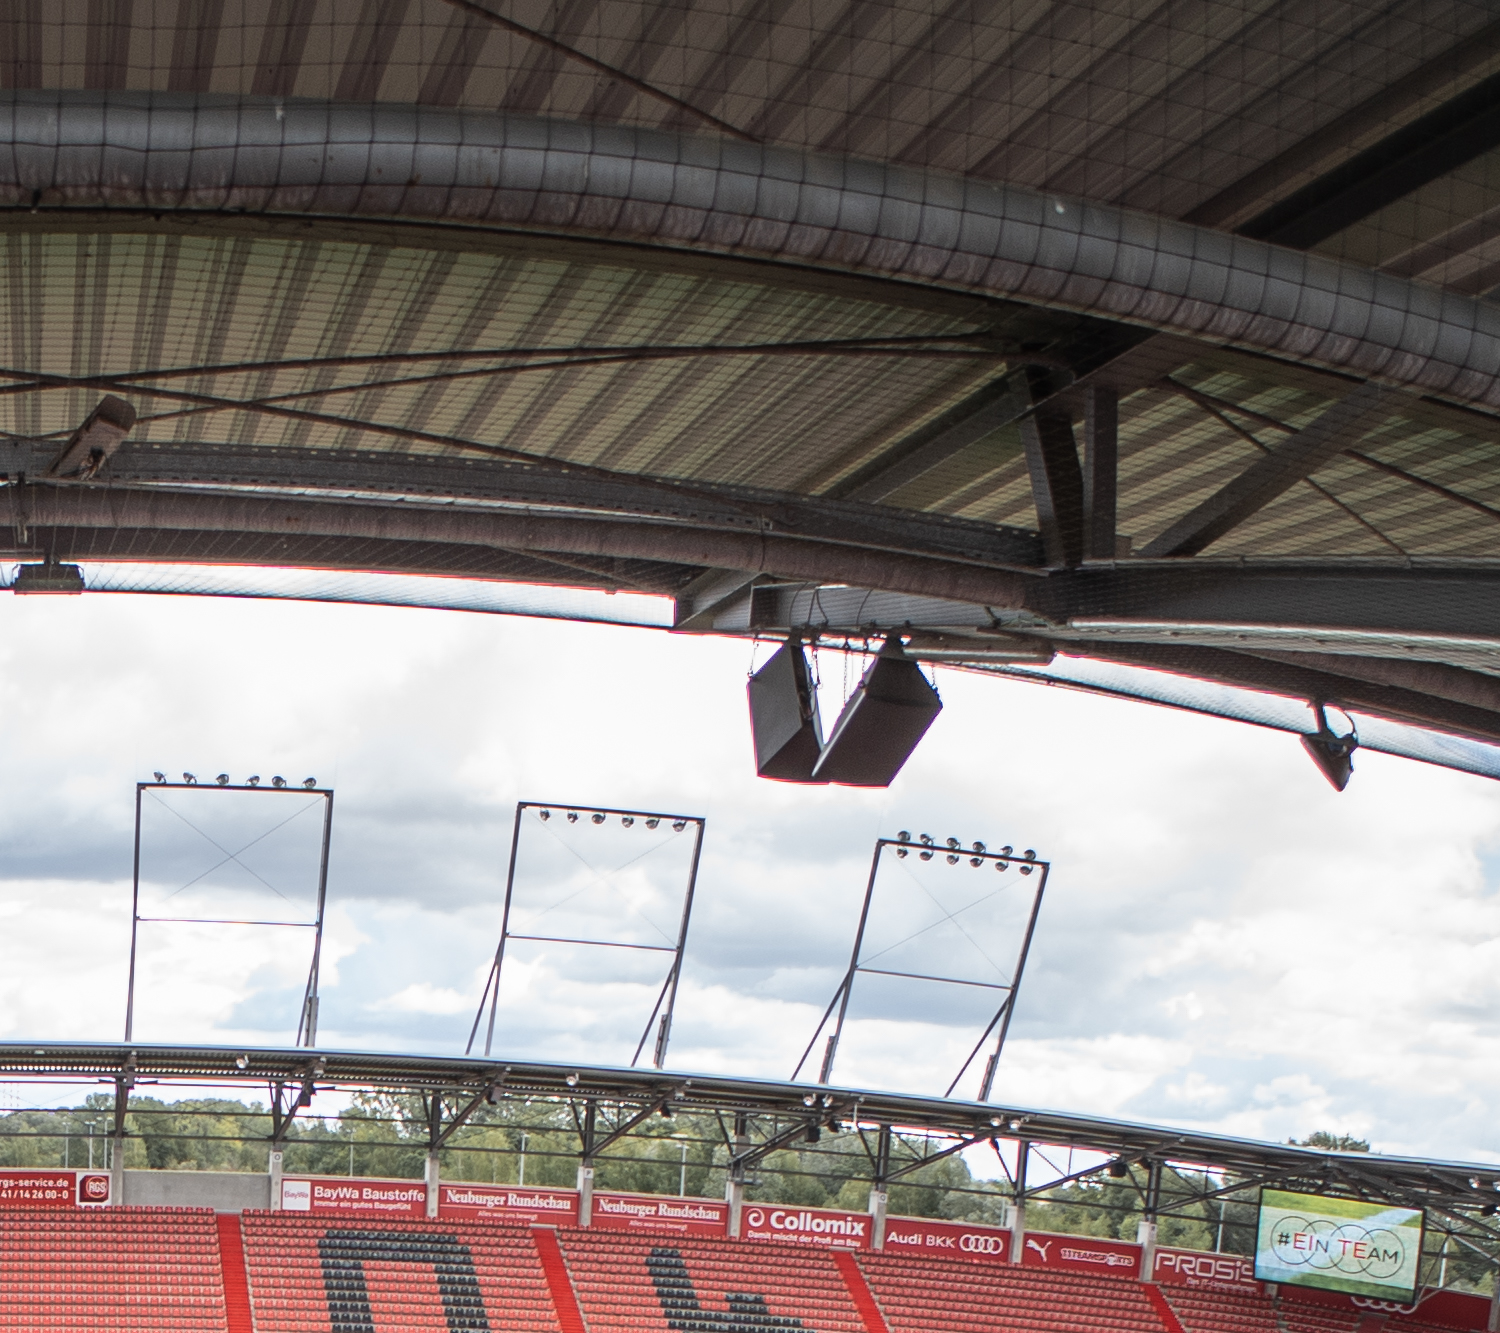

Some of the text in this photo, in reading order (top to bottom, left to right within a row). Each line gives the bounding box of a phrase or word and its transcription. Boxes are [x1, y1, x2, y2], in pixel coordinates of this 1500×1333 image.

[88, 1181, 107, 1193] RGS
[314, 1186, 426, 1202] BayWa Baustoffe
[314, 1200, 338, 1208] Immer
[352, 1202, 373, 1210] gutes
[374, 1201, 412, 1211] Baugefühl
[446, 1190, 571, 1210] Neuburger Rundschau
[599, 1199, 720, 1220] Neuburger Rundschau
[769, 1211, 865, 1237] Collomix
[748, 1230, 861, 1247] Damit mischt der Profi am Bau
[887, 1231, 955, 1249] Audi BKK
[1277, 1231, 1399, 1264] #EIN TEAM
